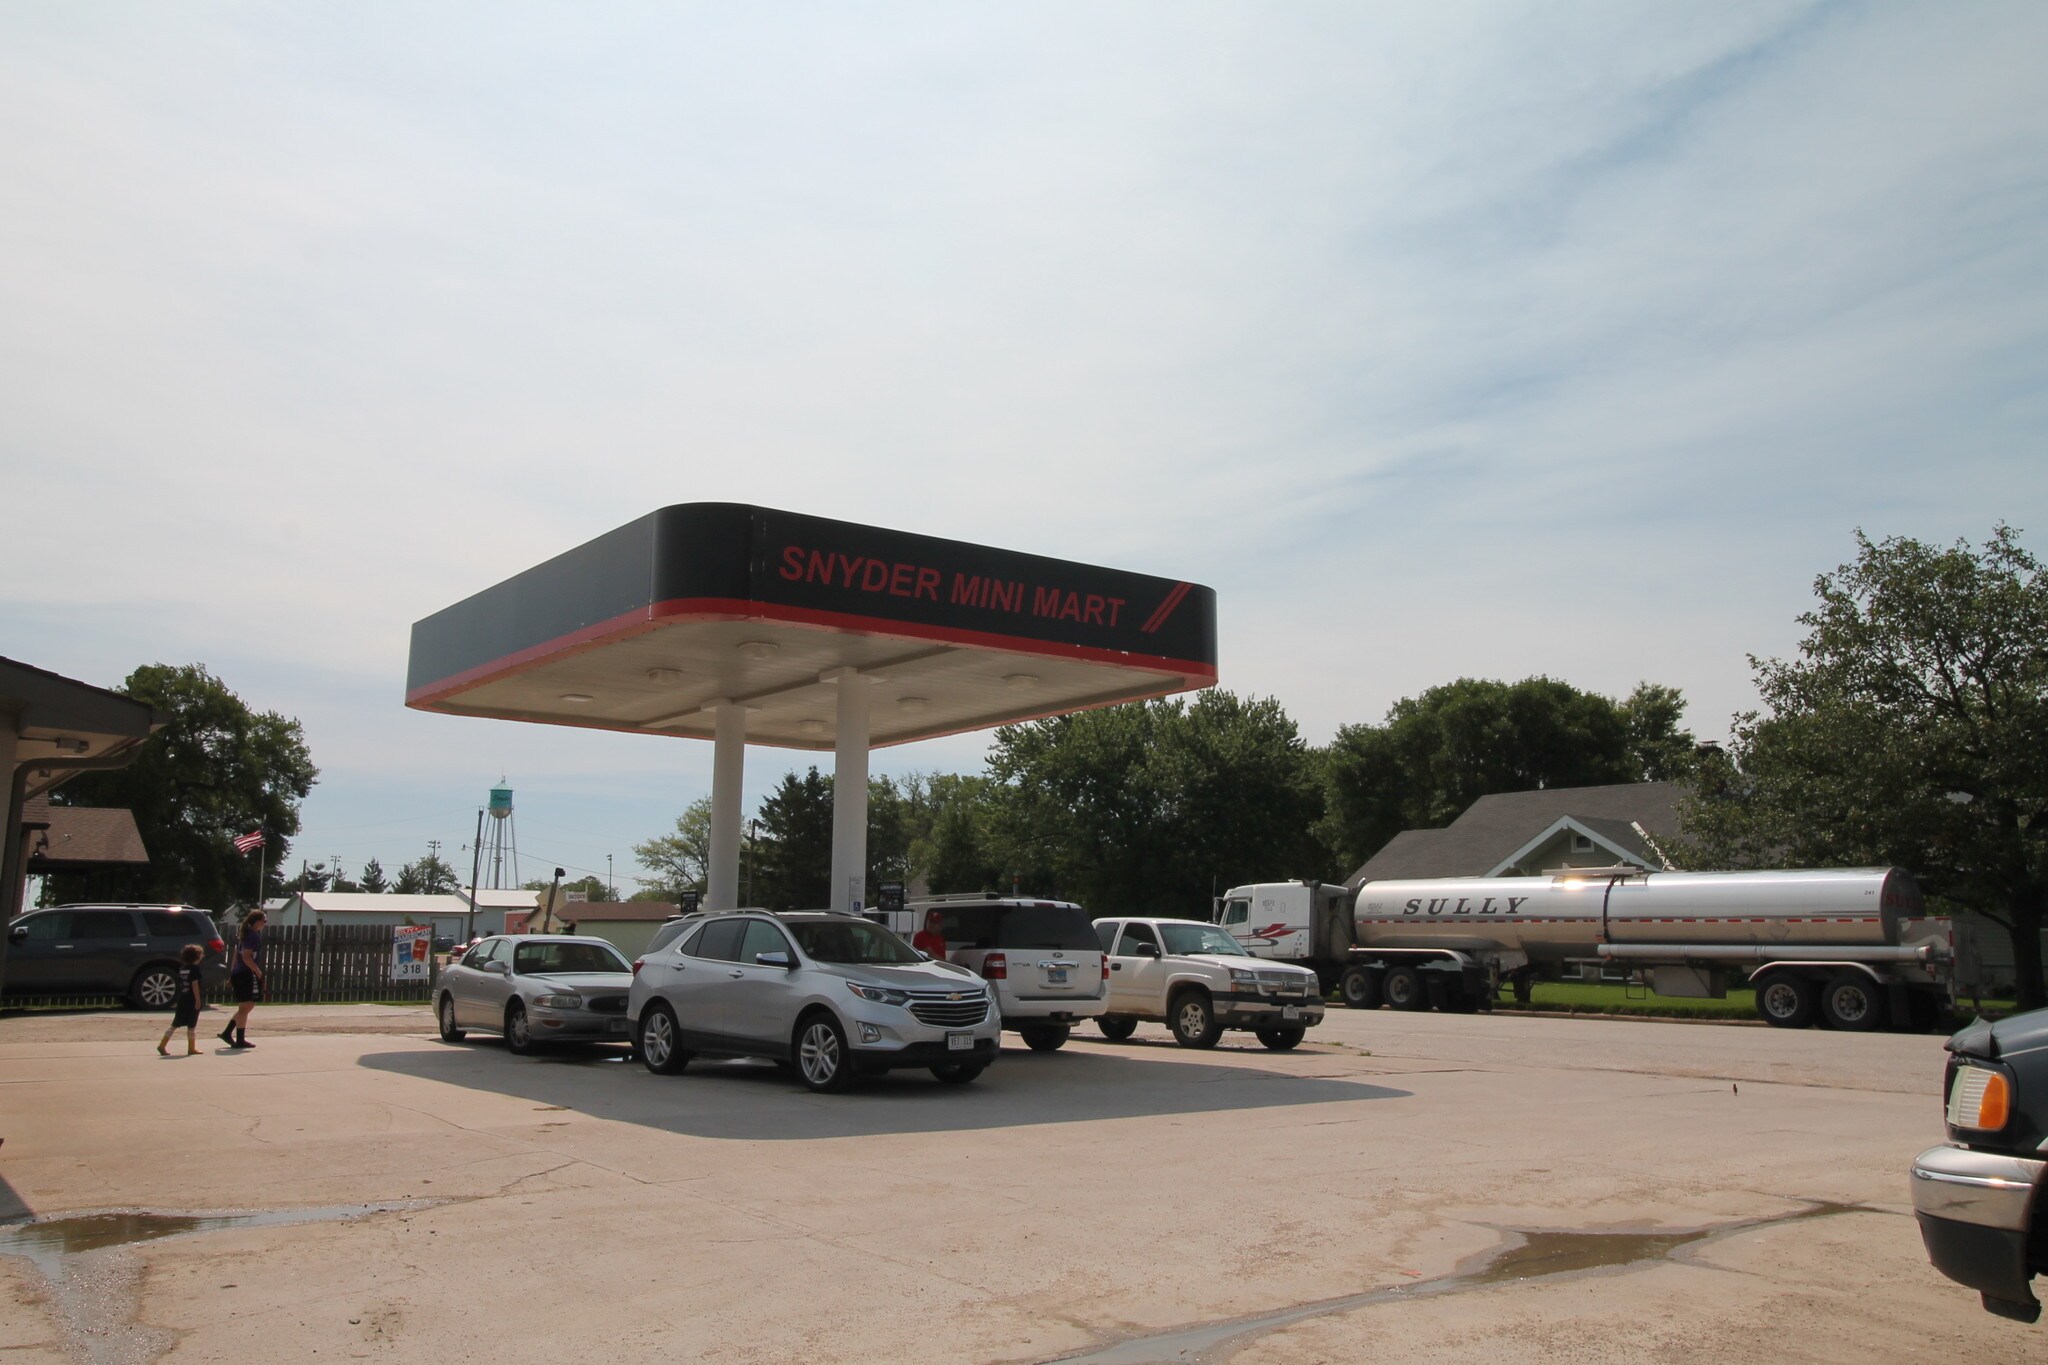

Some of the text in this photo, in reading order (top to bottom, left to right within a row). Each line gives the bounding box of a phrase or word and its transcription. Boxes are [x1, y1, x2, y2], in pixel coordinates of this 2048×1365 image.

[779, 545, 1126, 628] SNYDER MINI MART
[1402, 896, 1529, 916] SULLY
[402, 964, 421, 974] 318
